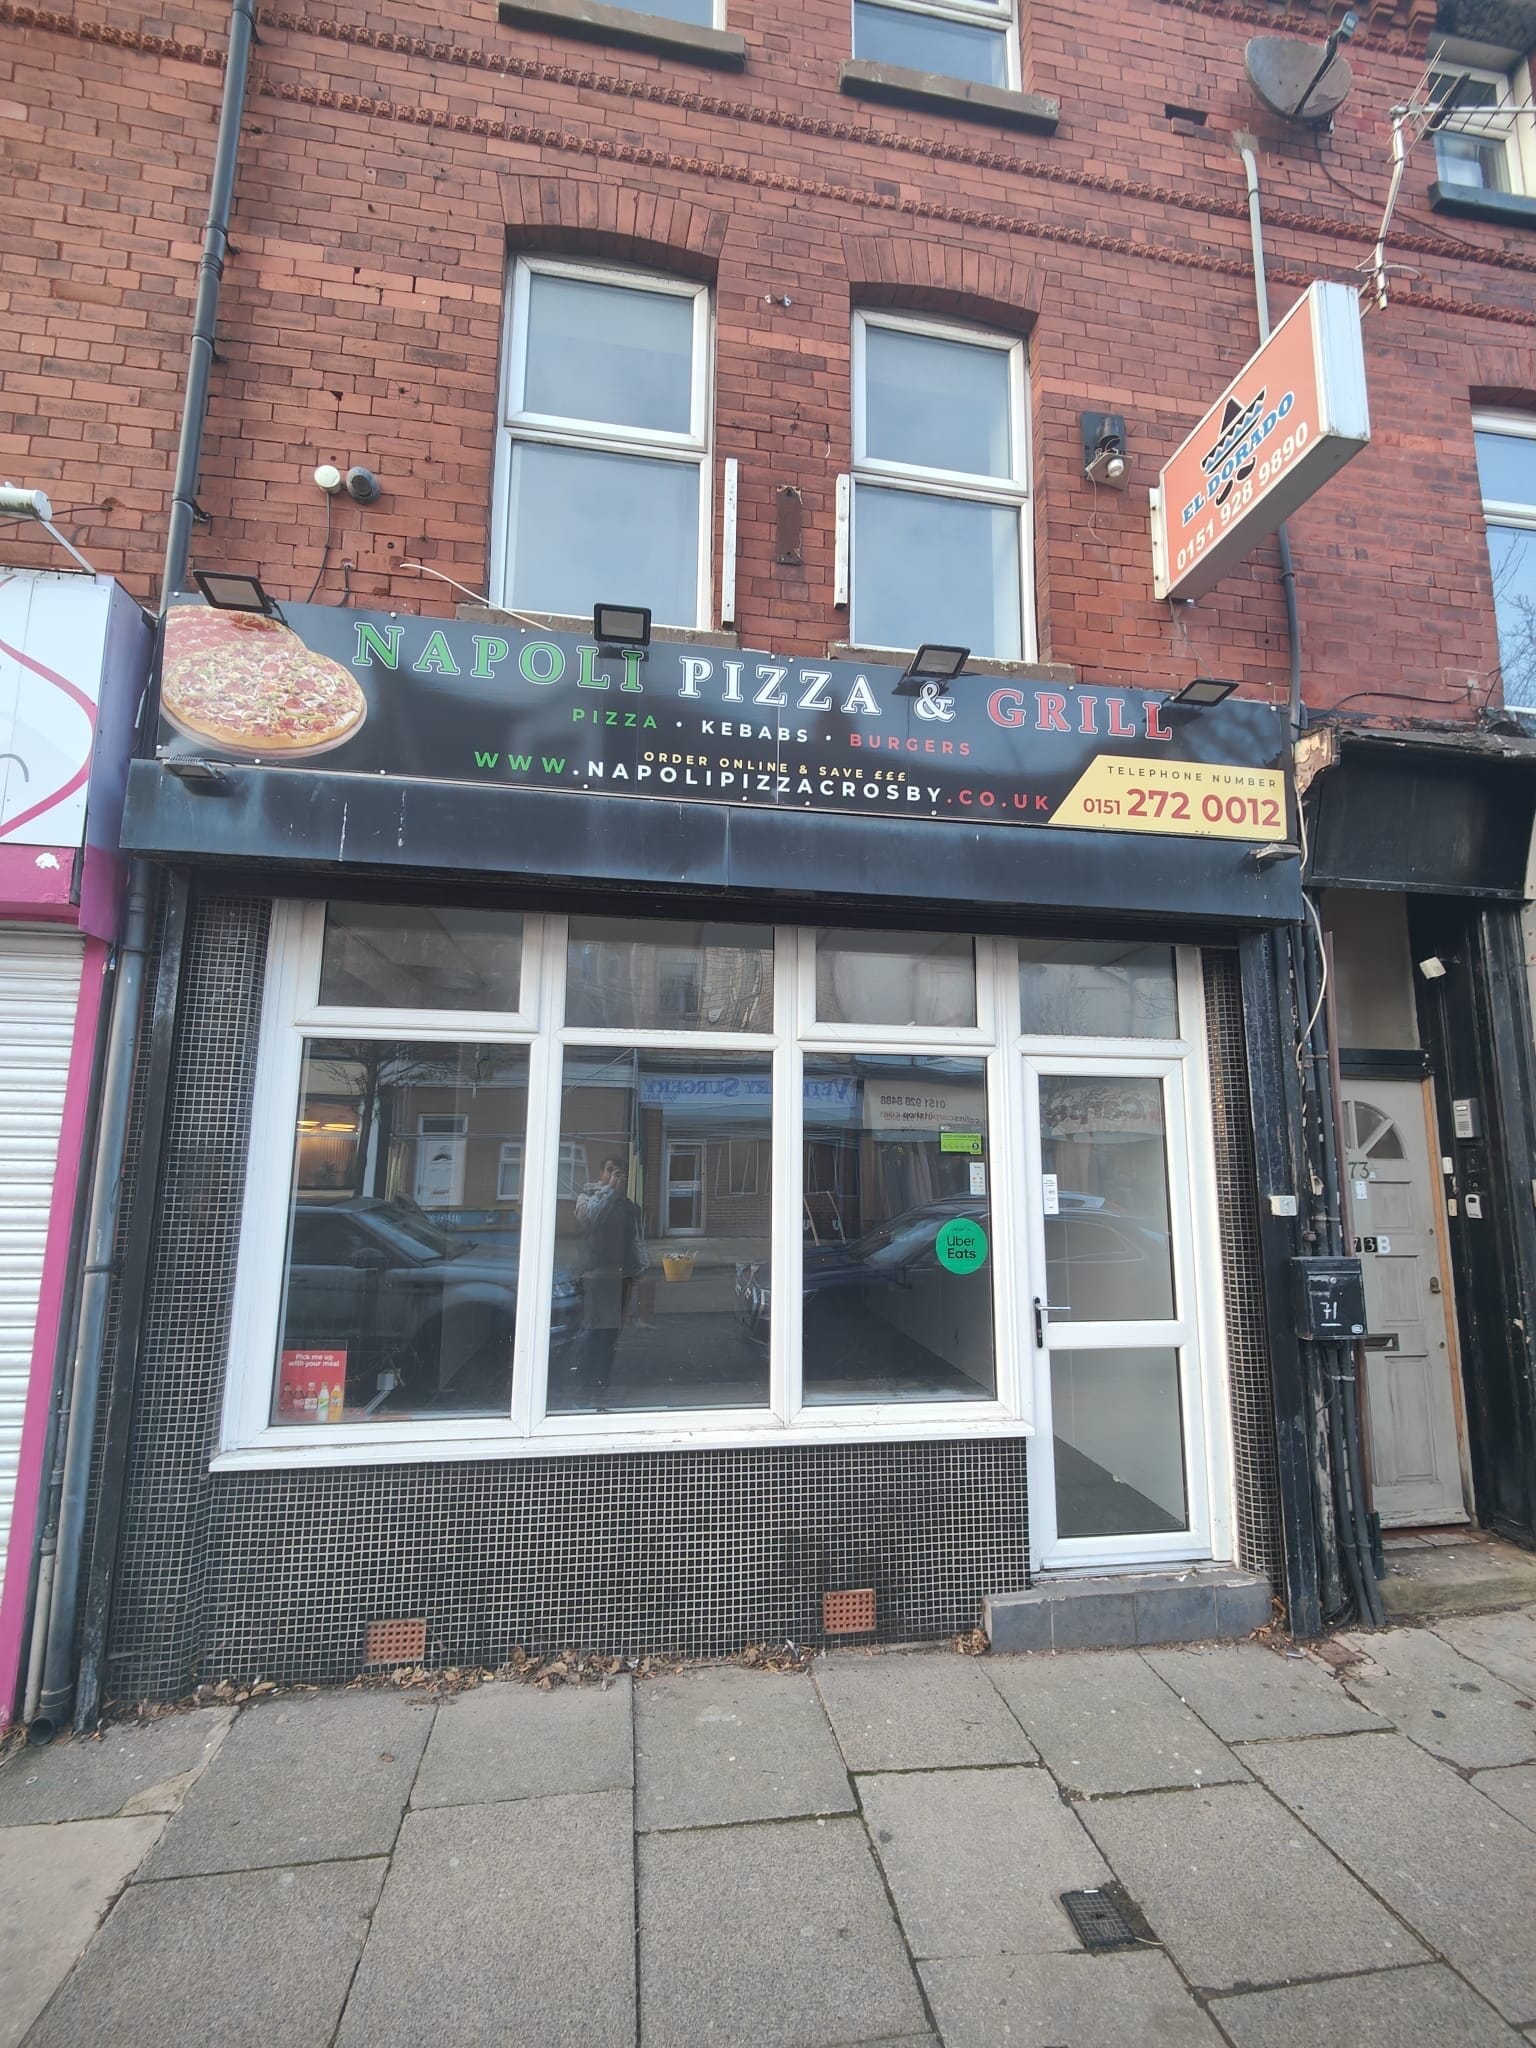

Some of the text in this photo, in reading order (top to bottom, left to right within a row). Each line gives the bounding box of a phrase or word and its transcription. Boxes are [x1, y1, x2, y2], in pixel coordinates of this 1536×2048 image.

[1182, 391, 1295, 527] EL DORADO
[1177, 422, 1309, 570] 0151 928 9890
[352, 621, 1173, 741] NAPOLI PIZZA & GRILL
[572, 708, 971, 756] PIZZA KEBABS BURGERS
[644, 751, 906, 782] ORDER ONLINE & SAVE £££
[1107, 765, 1277, 788] TELEPHONE NUMBER
[1083, 788, 1281, 827] 0151 272 0012
[946, 1235, 975, 1247] Uber
[947, 1247, 977, 1259] Eats
[1320, 1301, 1337, 1320] 71
